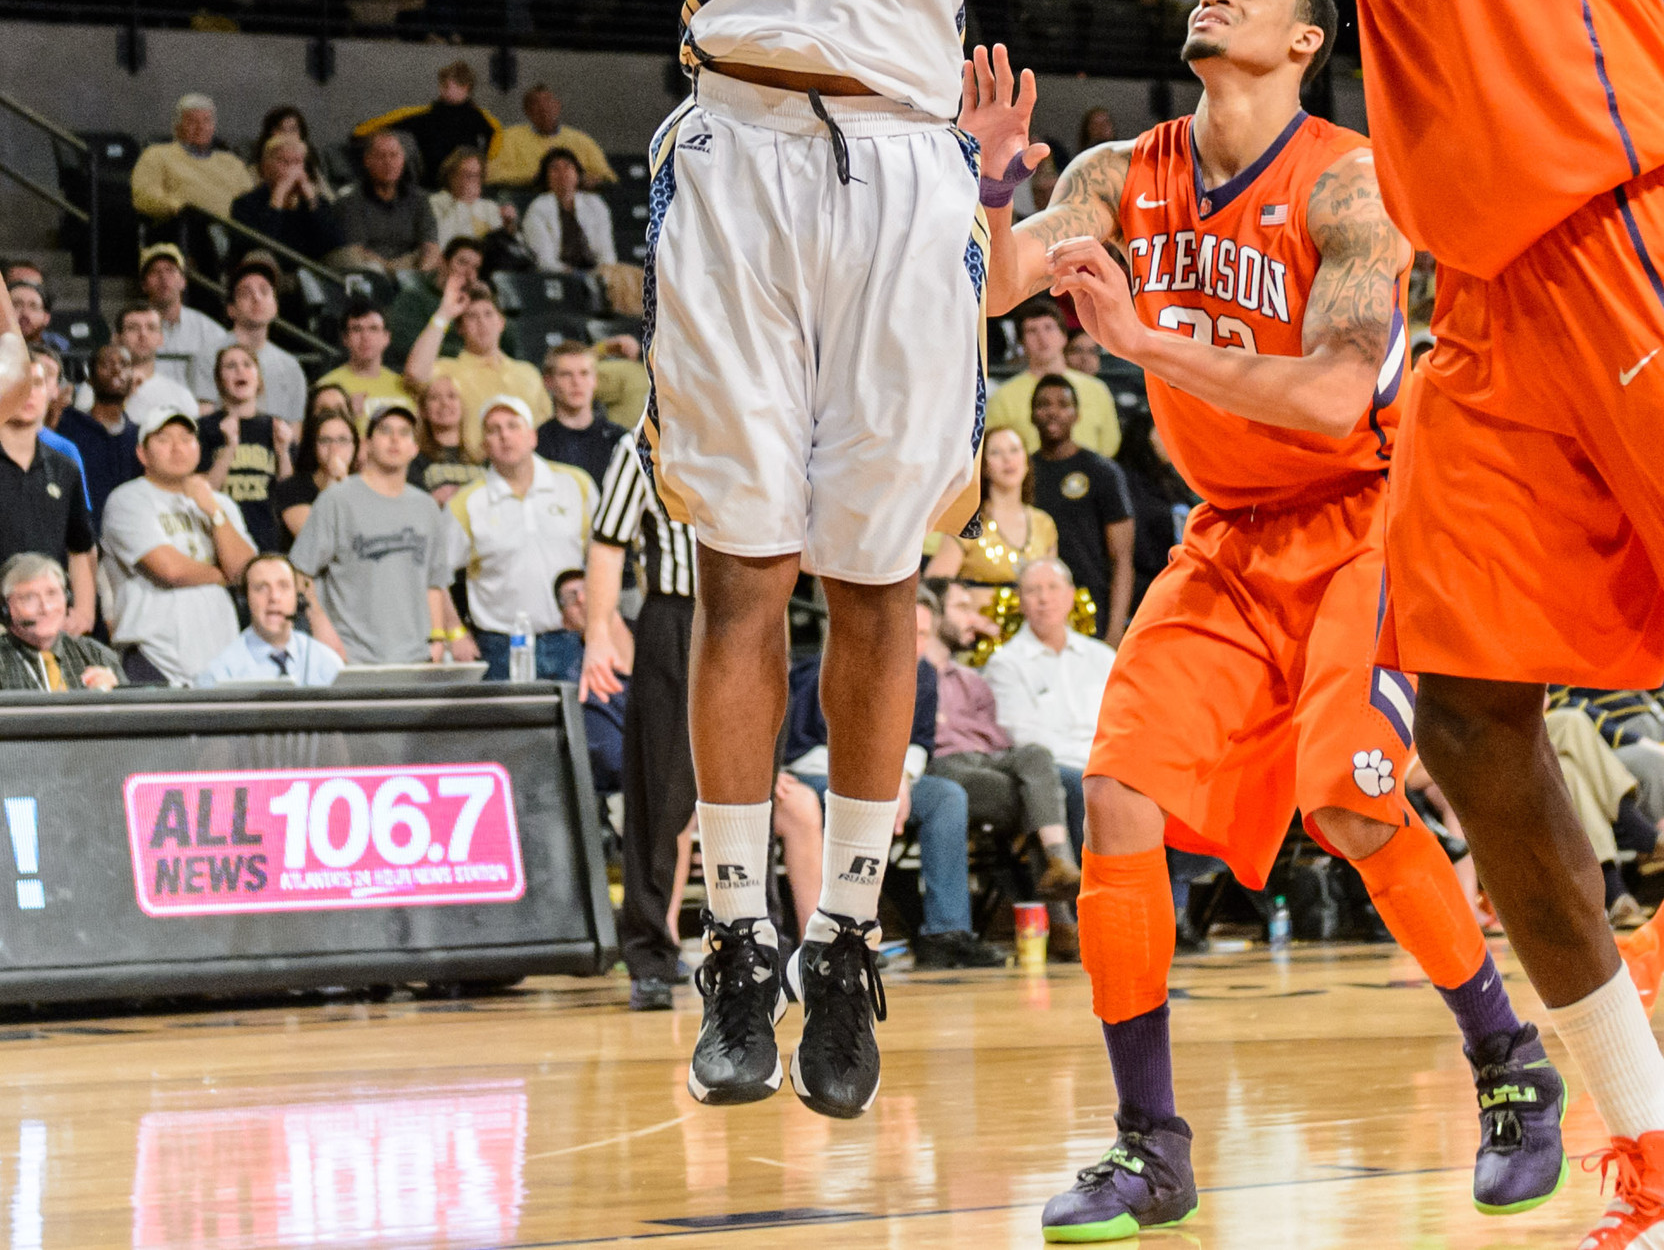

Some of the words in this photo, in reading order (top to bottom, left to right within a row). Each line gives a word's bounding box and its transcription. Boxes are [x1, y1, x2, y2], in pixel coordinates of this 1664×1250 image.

[1127, 230, 1291, 324] CLEMSON
[150, 787, 263, 849] ALL
[269, 776, 495, 869] 106.7
[155, 854, 268, 895] NEWS
